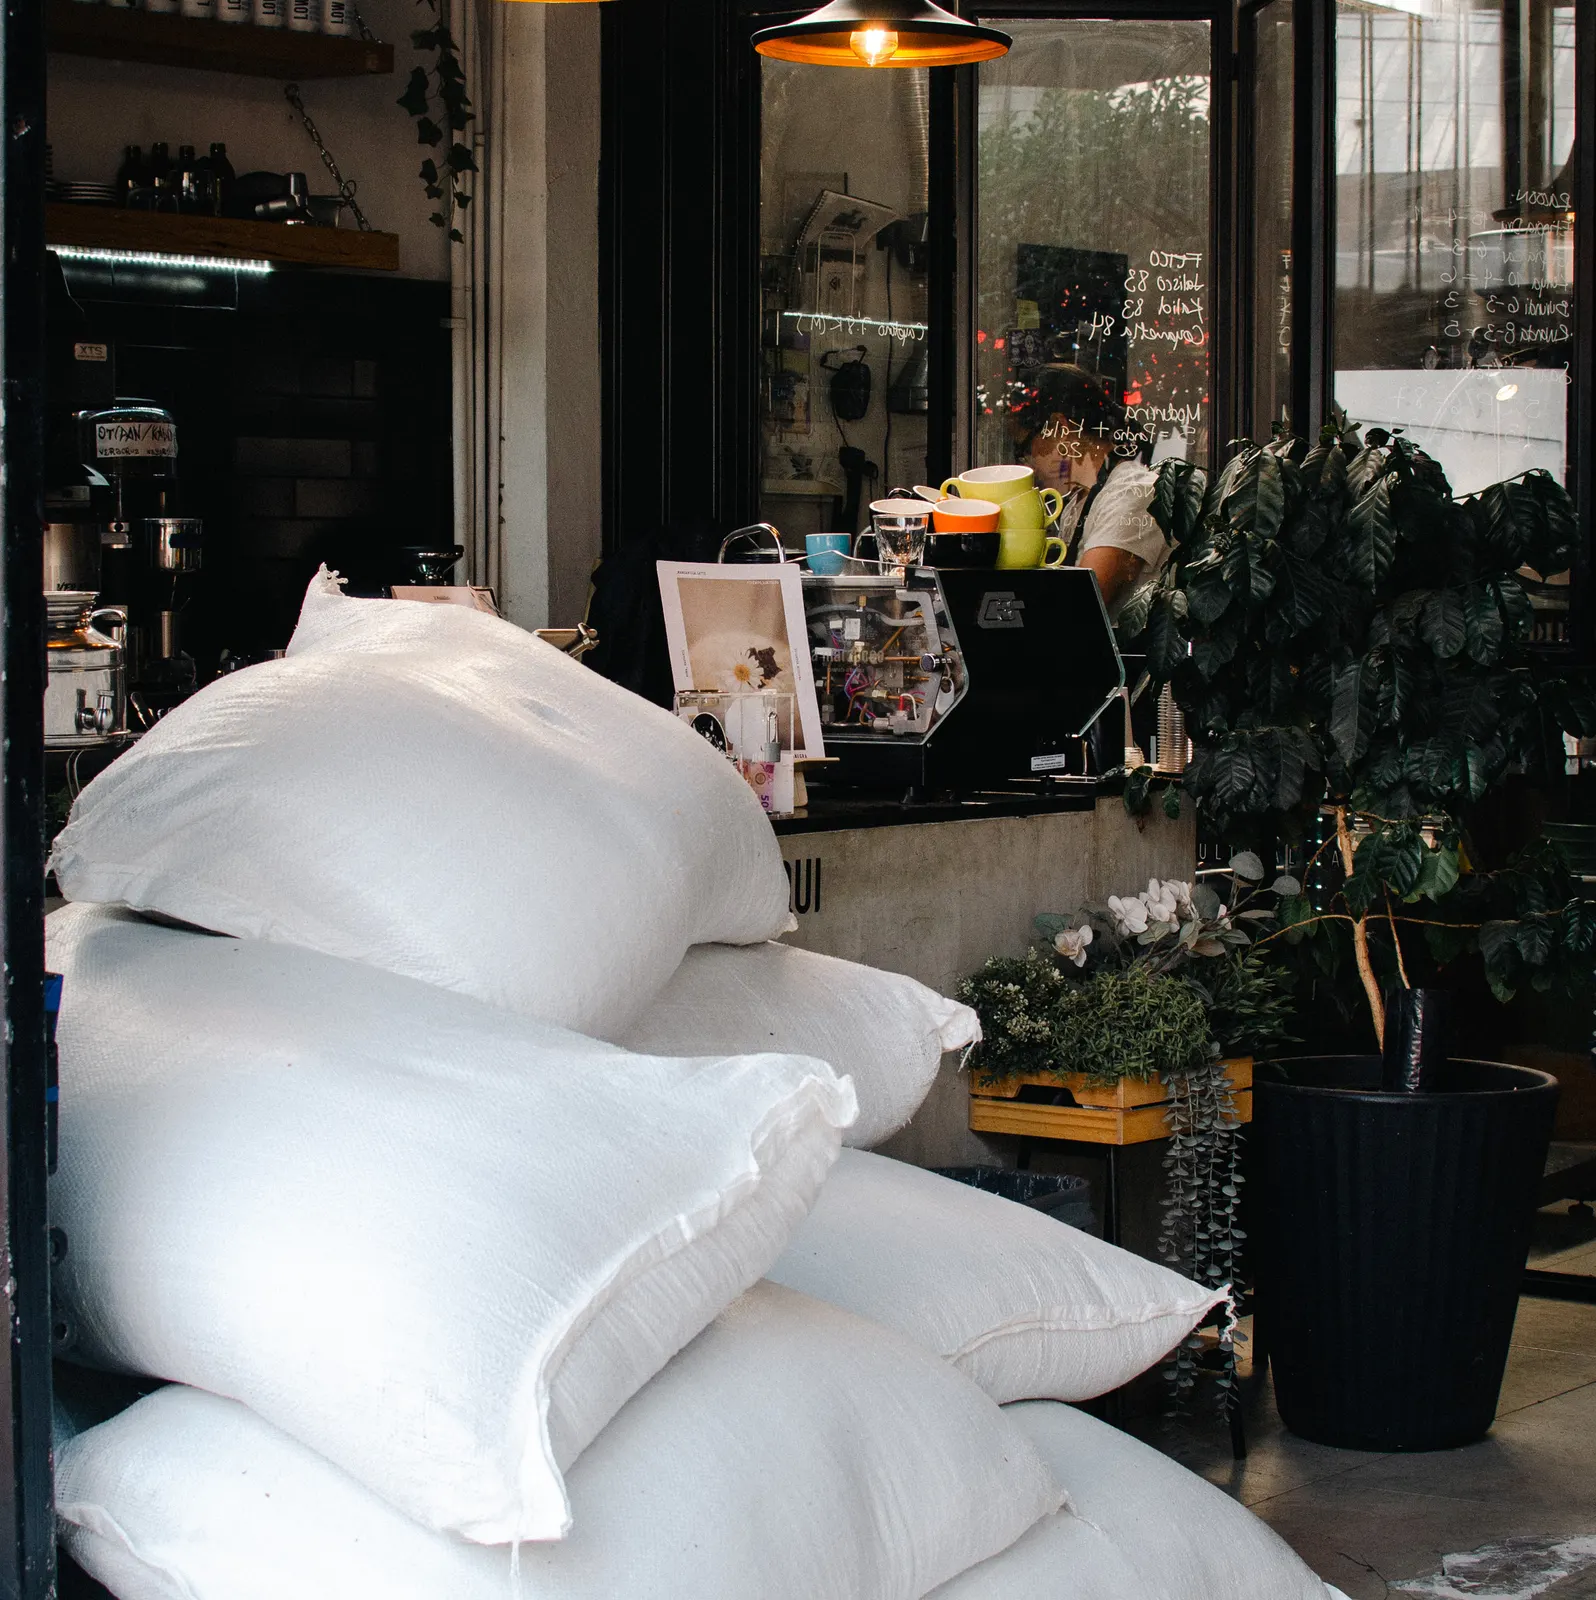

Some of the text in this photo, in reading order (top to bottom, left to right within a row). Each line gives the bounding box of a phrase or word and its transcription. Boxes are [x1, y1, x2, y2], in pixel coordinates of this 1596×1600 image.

[262, 0, 276, 15] LO
[331, 1, 345, 25] LOW
[80, 345, 103, 355] XTS
[783, 857, 821, 914] UI
